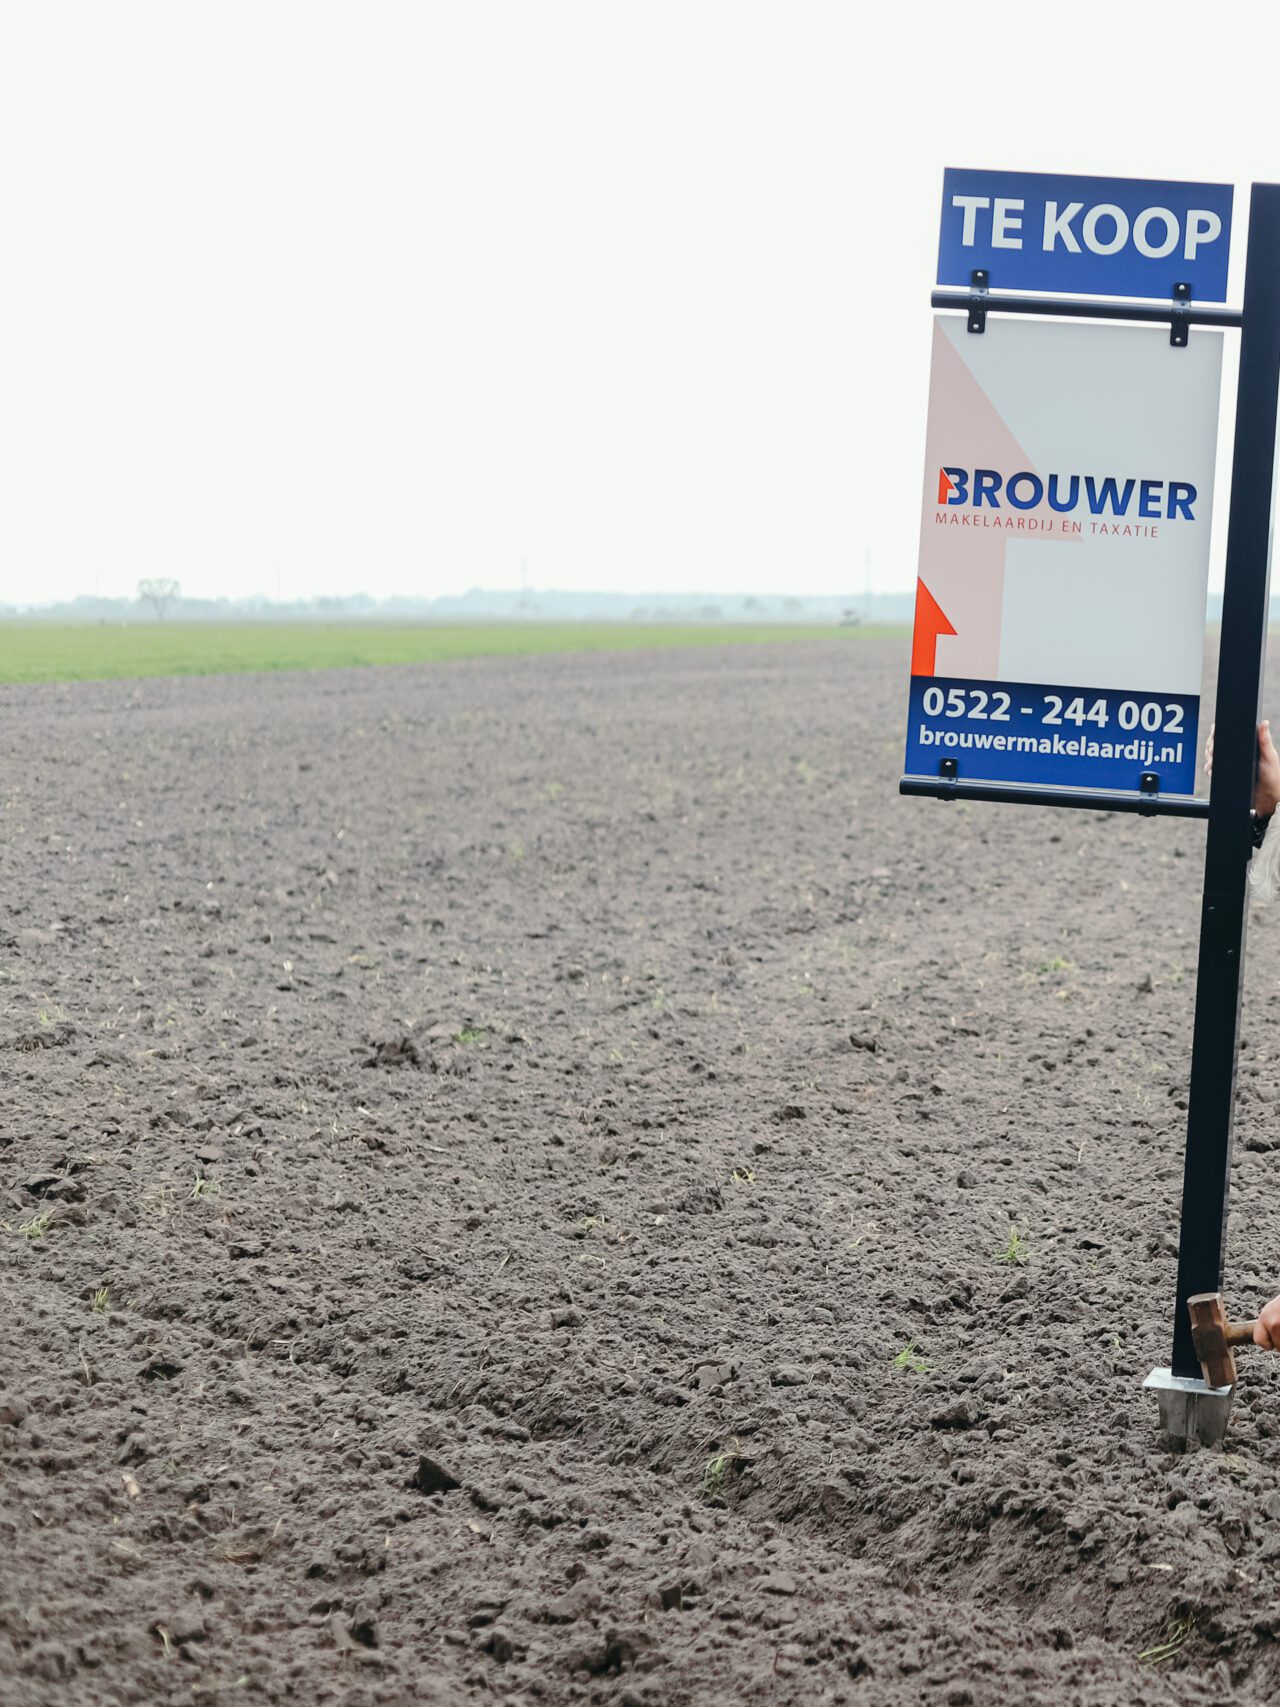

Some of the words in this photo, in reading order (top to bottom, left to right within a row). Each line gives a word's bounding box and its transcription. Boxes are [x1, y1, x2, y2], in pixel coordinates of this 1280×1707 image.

[952, 195, 1024, 250] TE
[1042, 200, 1222, 261] KOOP
[938, 466, 1197, 521] BROUWER
[935, 512, 1054, 532] MAKELAARDIJ
[1062, 521, 1082, 533] EN
[1090, 522, 1158, 538] TAXATIE
[922, 686, 1011, 721] 0522
[1041, 695, 1109, 728] 244
[1117, 700, 1185, 734] 002
[919, 724, 1183, 766] brouwermakelaardij.nl
